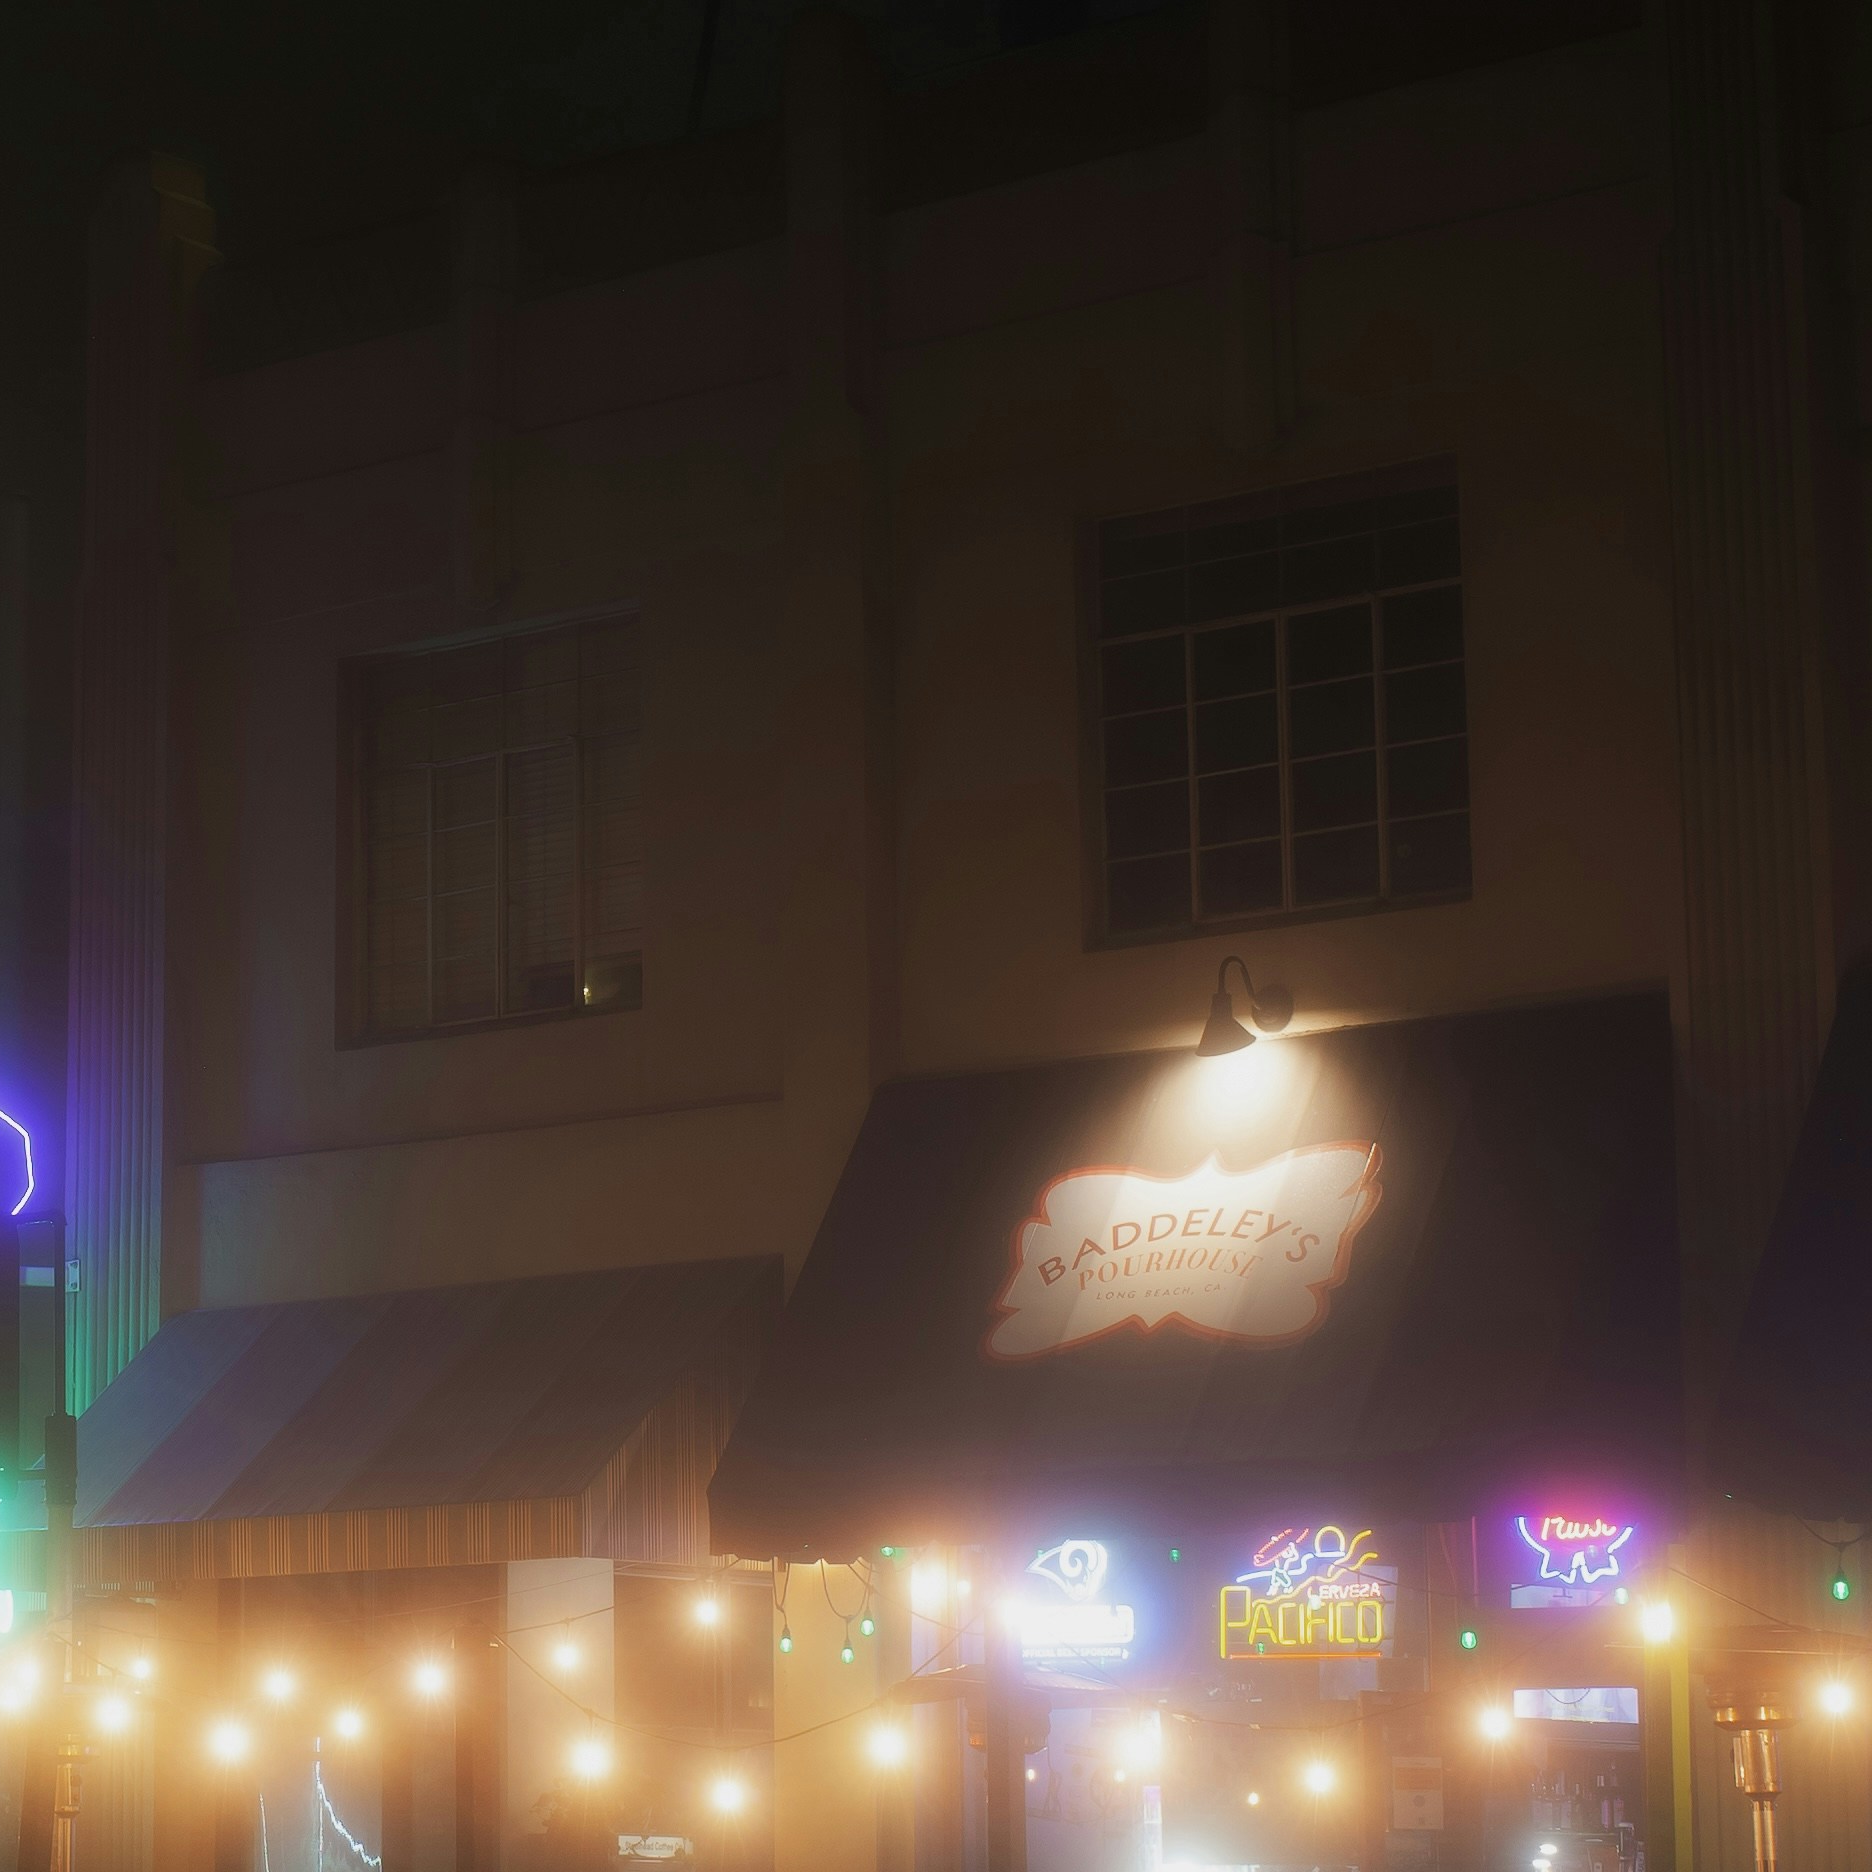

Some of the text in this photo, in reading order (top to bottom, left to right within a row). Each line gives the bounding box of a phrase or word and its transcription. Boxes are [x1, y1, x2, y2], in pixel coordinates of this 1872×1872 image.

[1037, 1208, 1321, 1287] BADDELEY'S
[1078, 1247, 1264, 1291] POURHOUSE
[1096, 1290, 1137, 1301] LONG
[1144, 1286, 1195, 1298] BEACH,
[1220, 1586, 1383, 1659] PACIFICO
